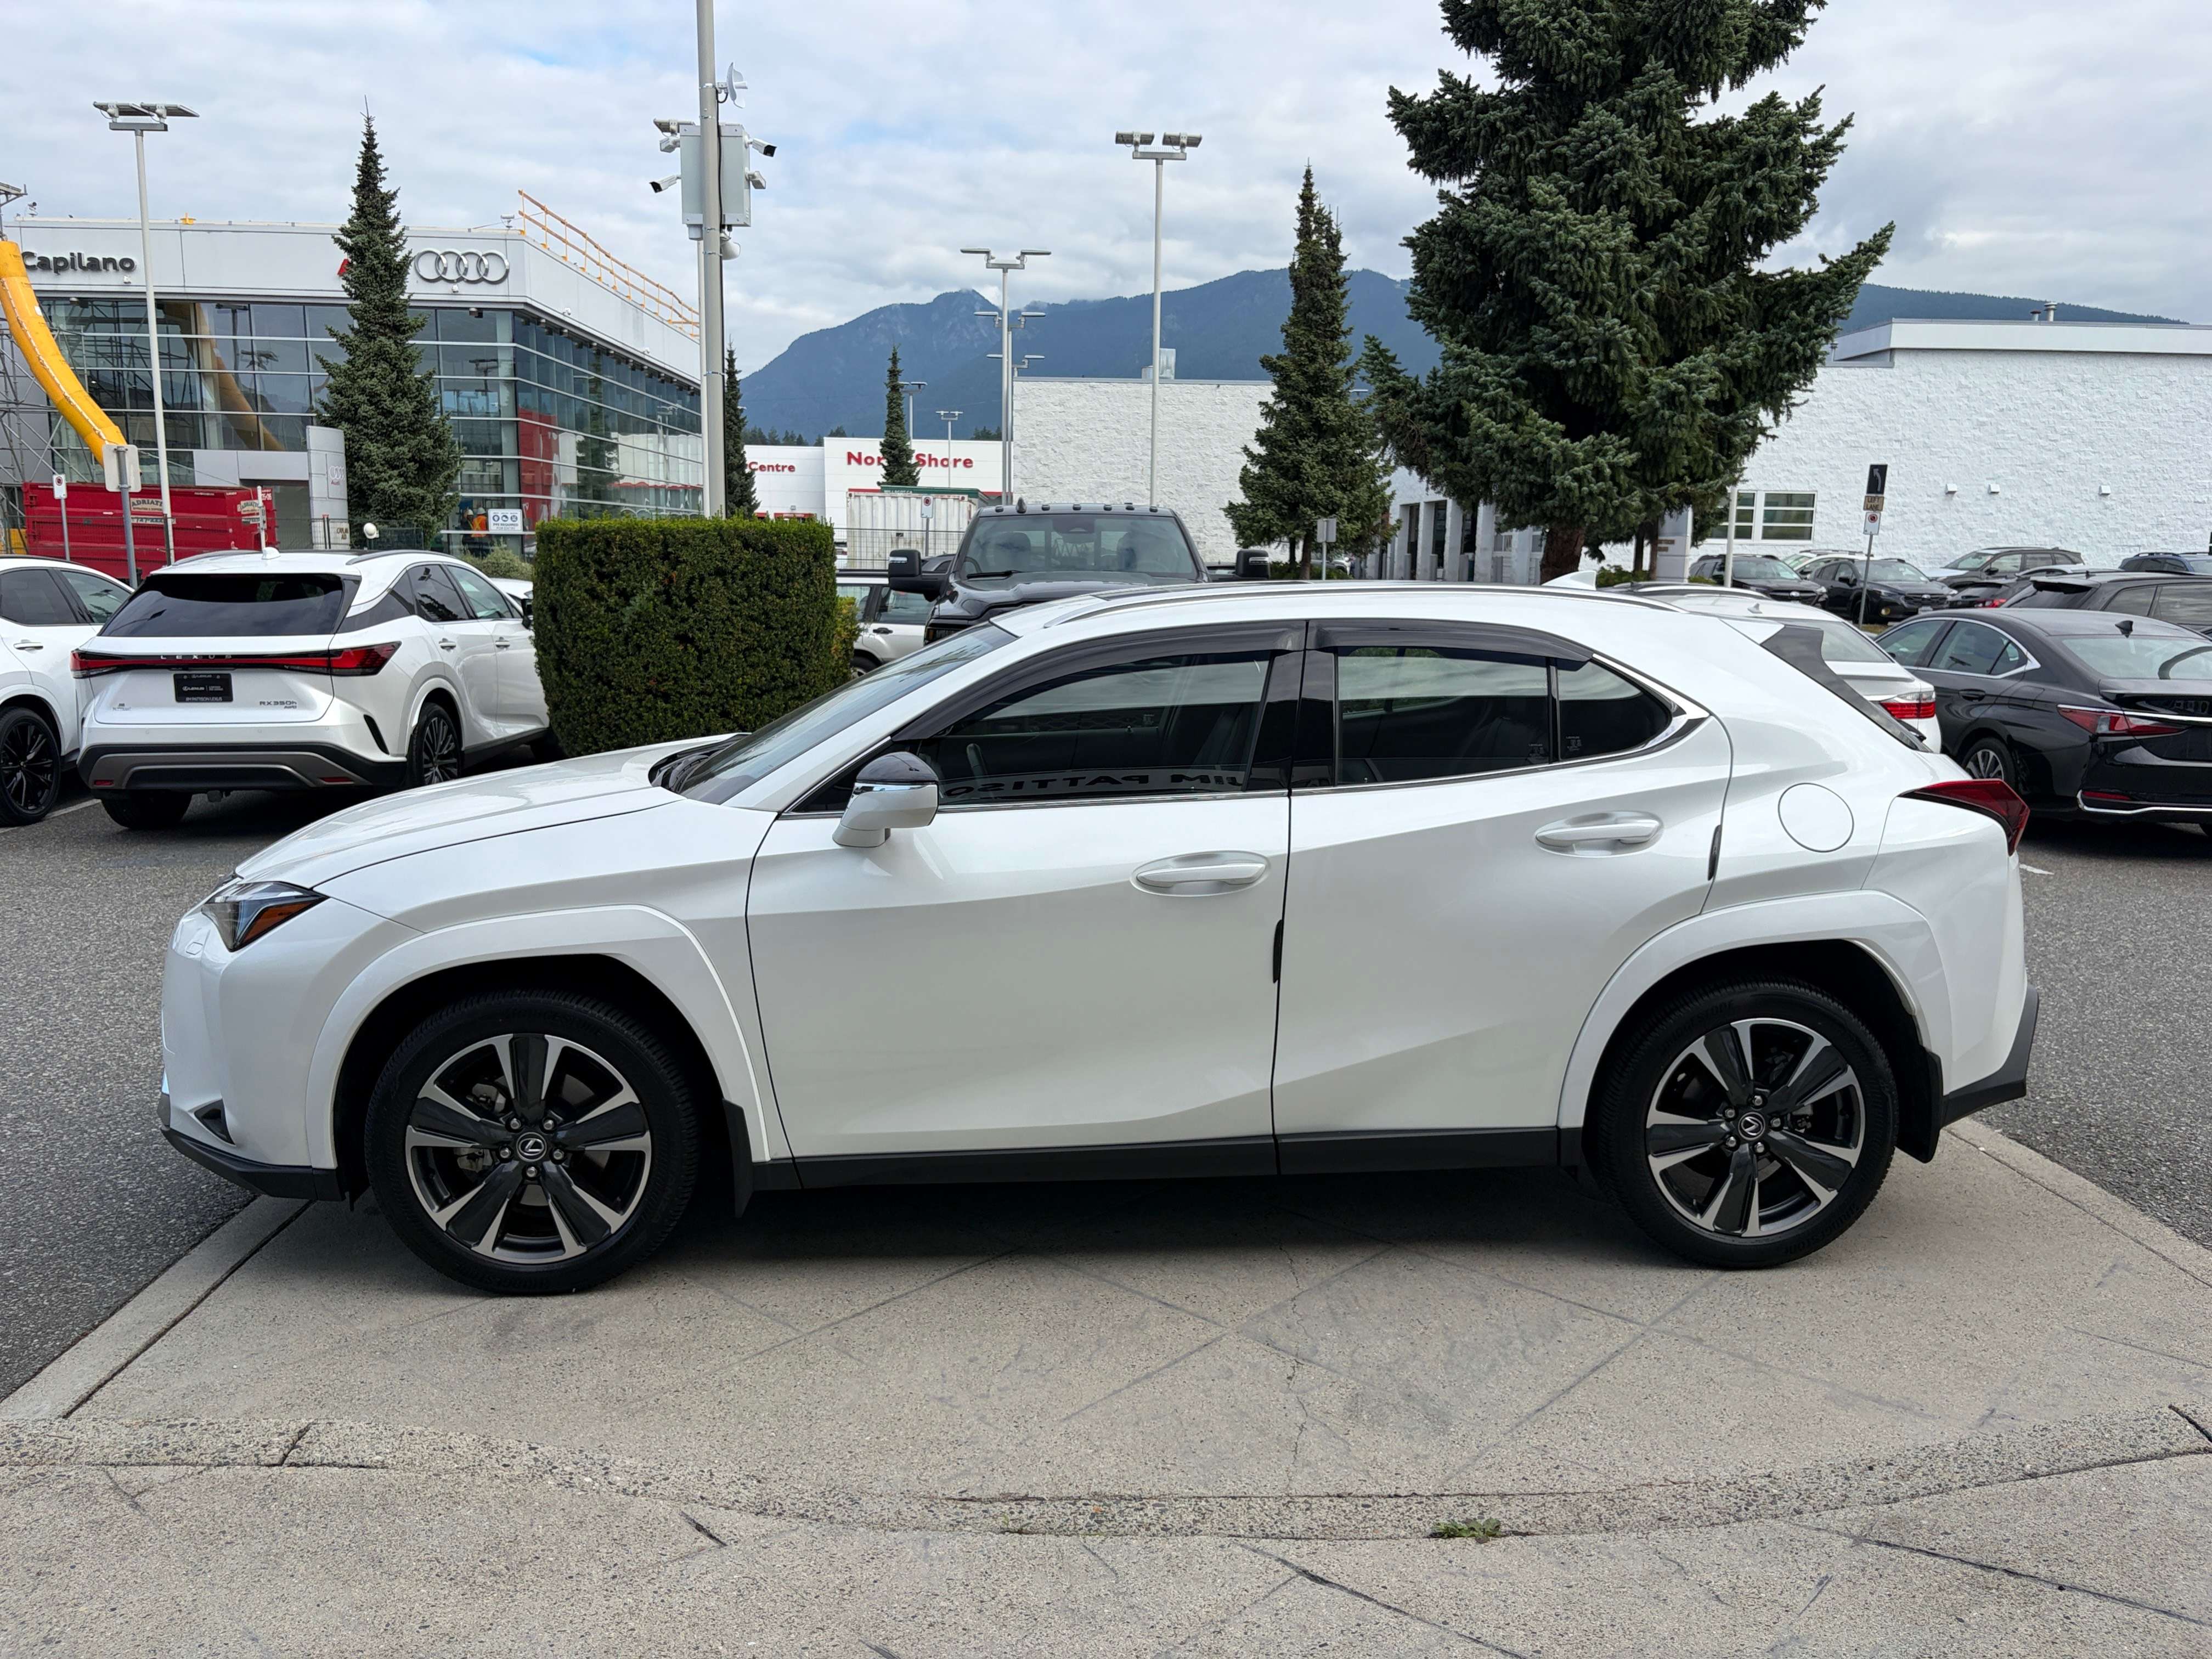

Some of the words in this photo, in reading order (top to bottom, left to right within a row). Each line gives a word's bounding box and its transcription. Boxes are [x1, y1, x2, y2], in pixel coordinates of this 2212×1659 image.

[21, 251, 136, 274] Capilano
[748, 461, 795, 472] Centre
[847, 452, 885, 466] Nor
[916, 453, 973, 468] Shore
